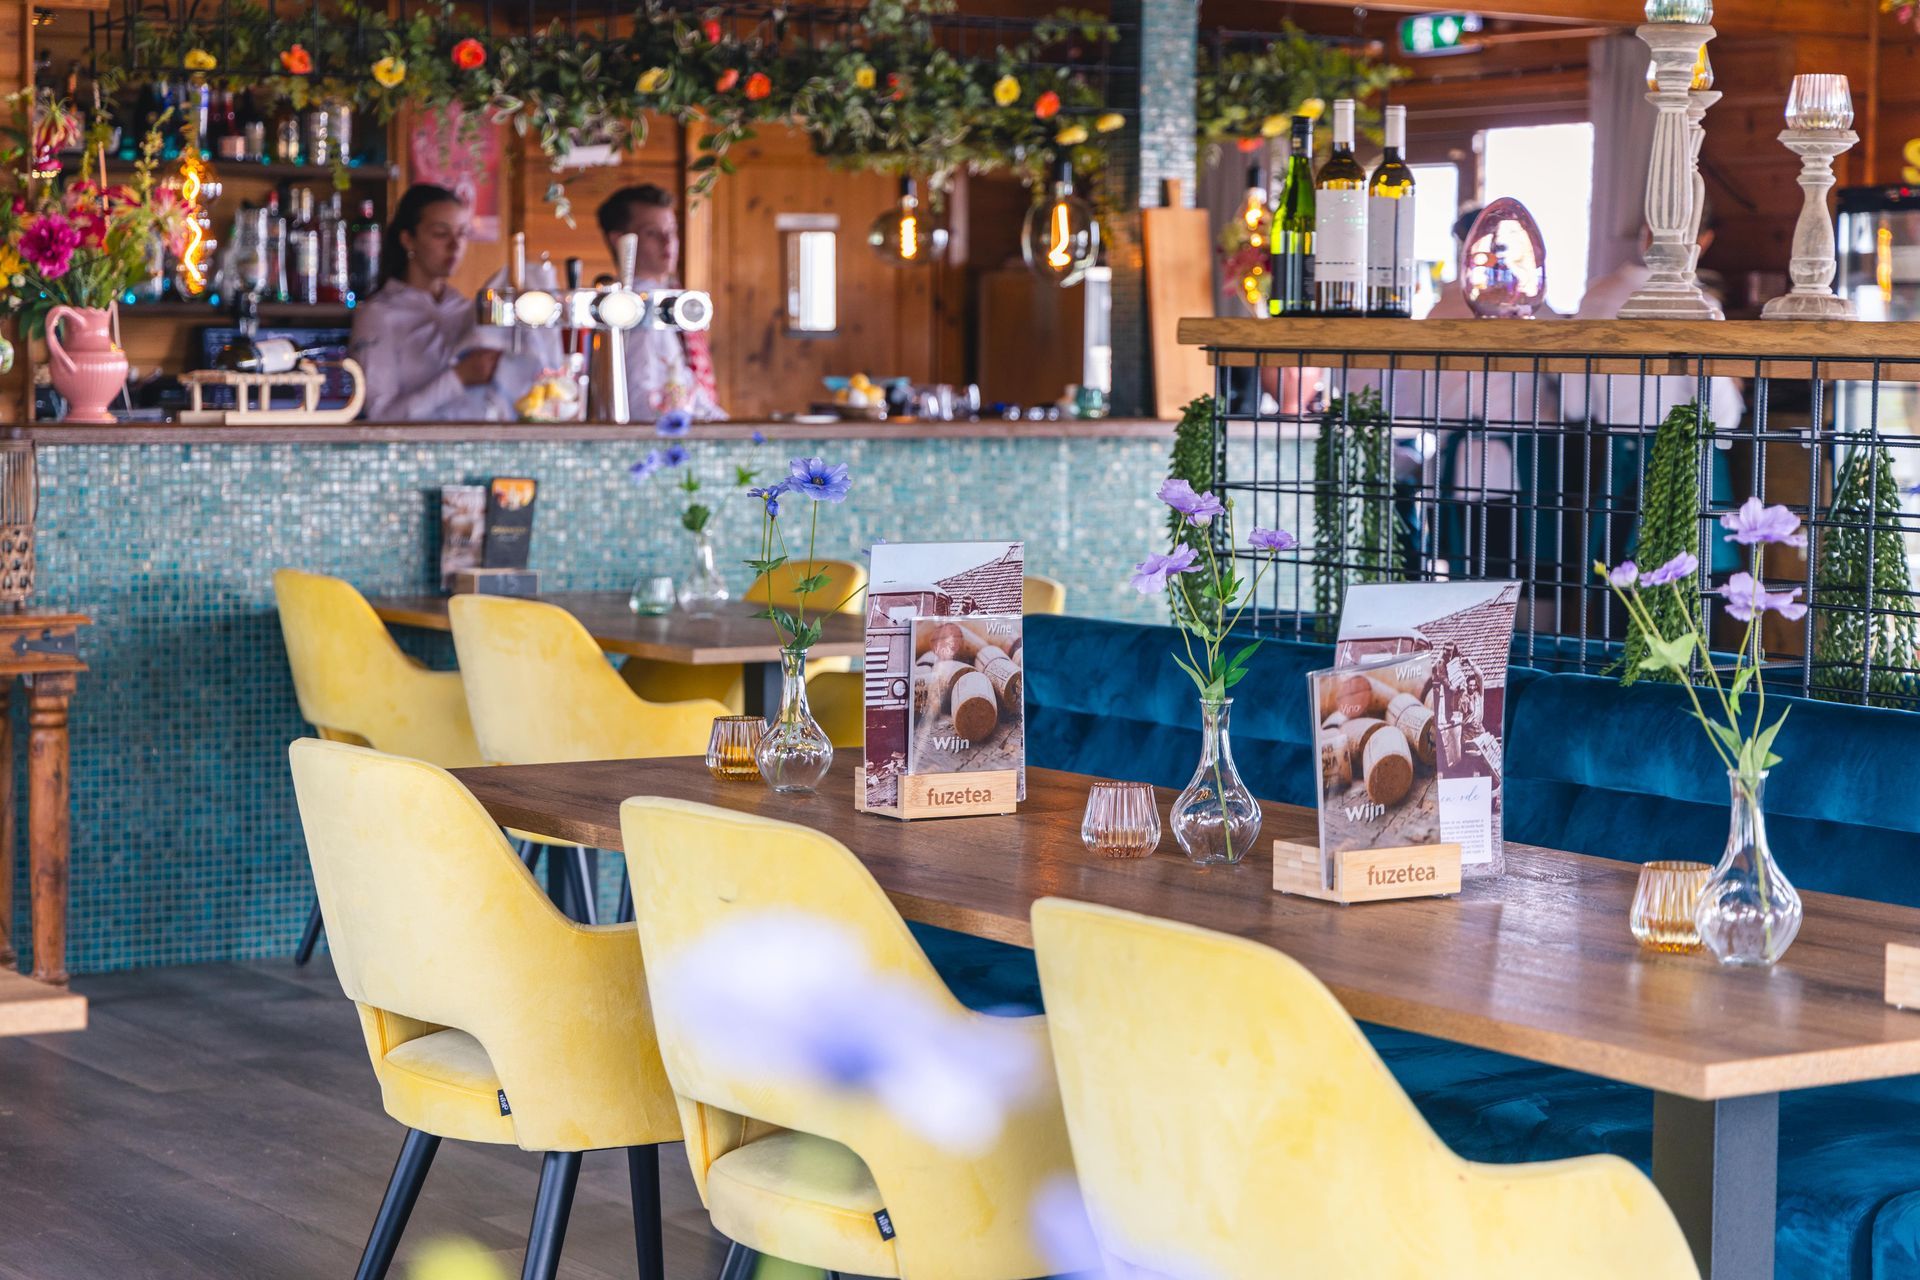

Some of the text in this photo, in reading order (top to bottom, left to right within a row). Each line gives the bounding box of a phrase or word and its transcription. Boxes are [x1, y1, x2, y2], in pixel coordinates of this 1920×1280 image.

[986, 622, 1012, 635] Wine
[1395, 665, 1422, 680] Wine
[1340, 703, 1361, 714] Vino
[933, 736, 970, 754] Wijn
[927, 787, 992, 806] fuzetea
[1345, 803, 1385, 823] Wijn
[1367, 864, 1436, 886] fuzetea
